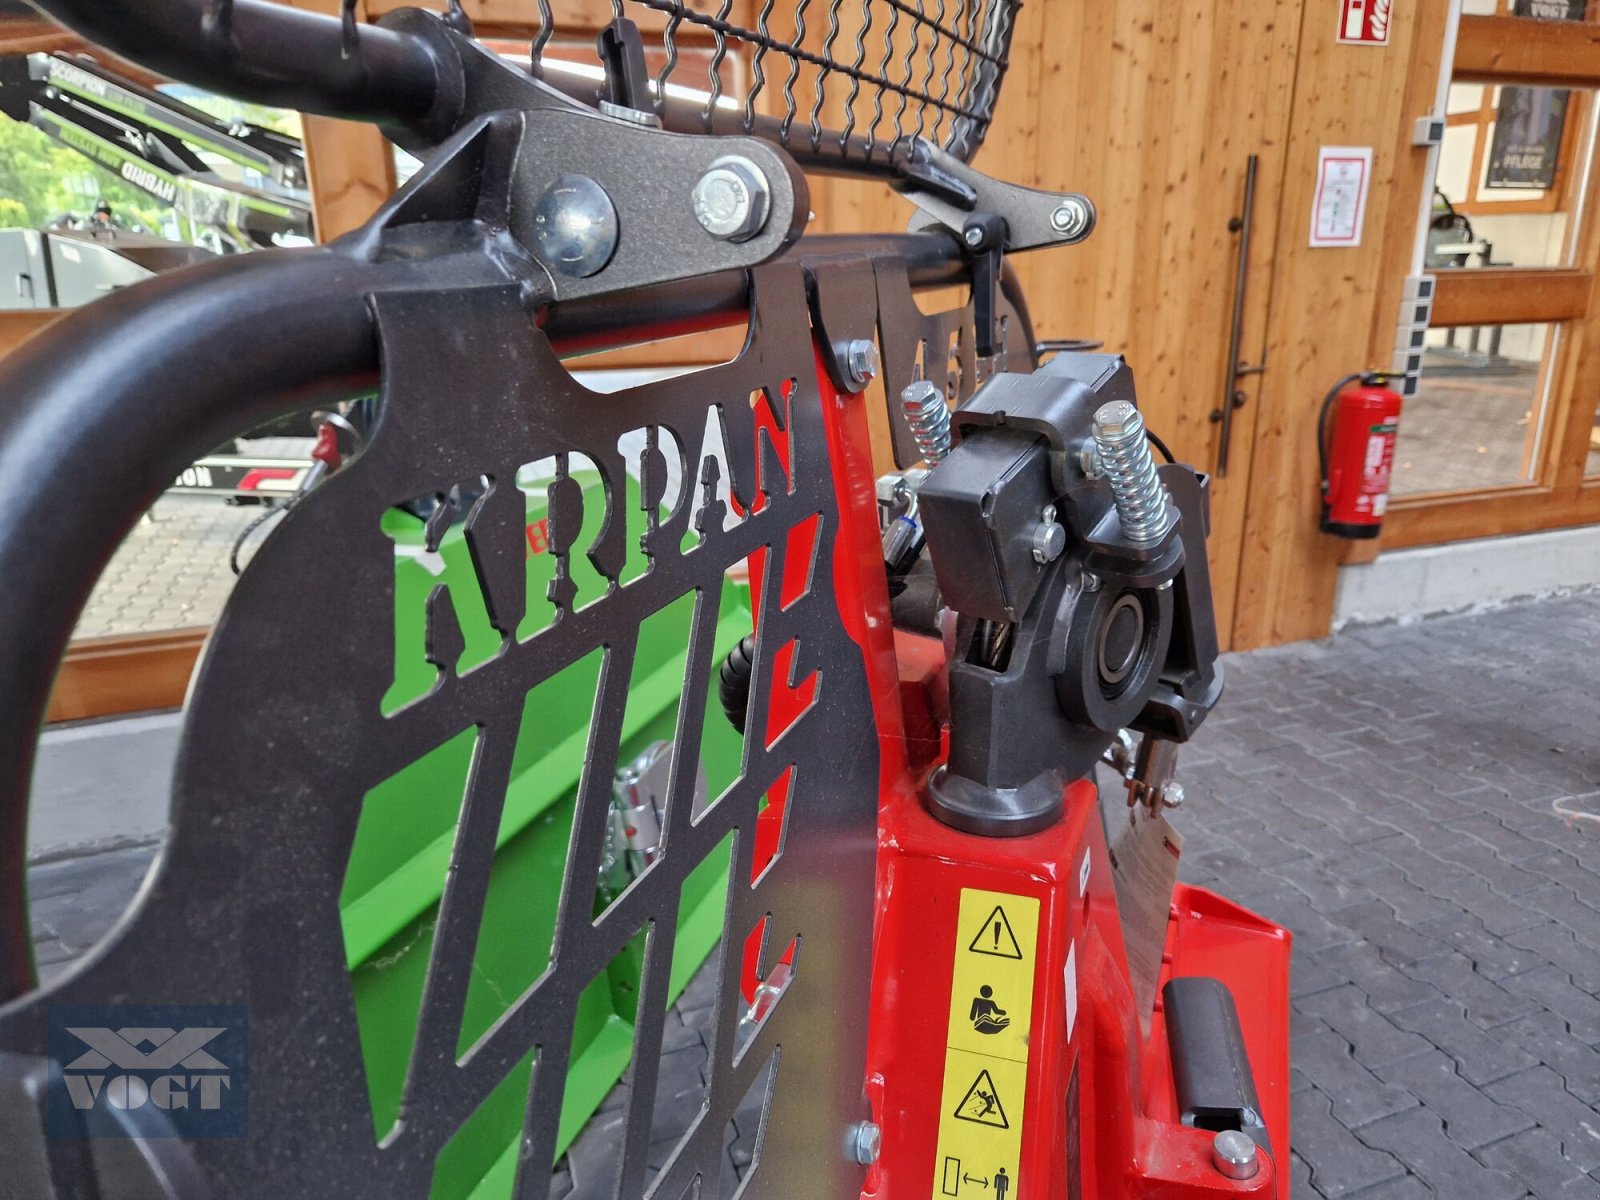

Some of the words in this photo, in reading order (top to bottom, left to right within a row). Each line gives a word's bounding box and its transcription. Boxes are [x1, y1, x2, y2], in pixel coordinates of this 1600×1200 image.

[50, 62, 105, 95] SCORPION
[123, 161, 175, 202] HYBRID
[380, 376, 798, 719] KRPAN
